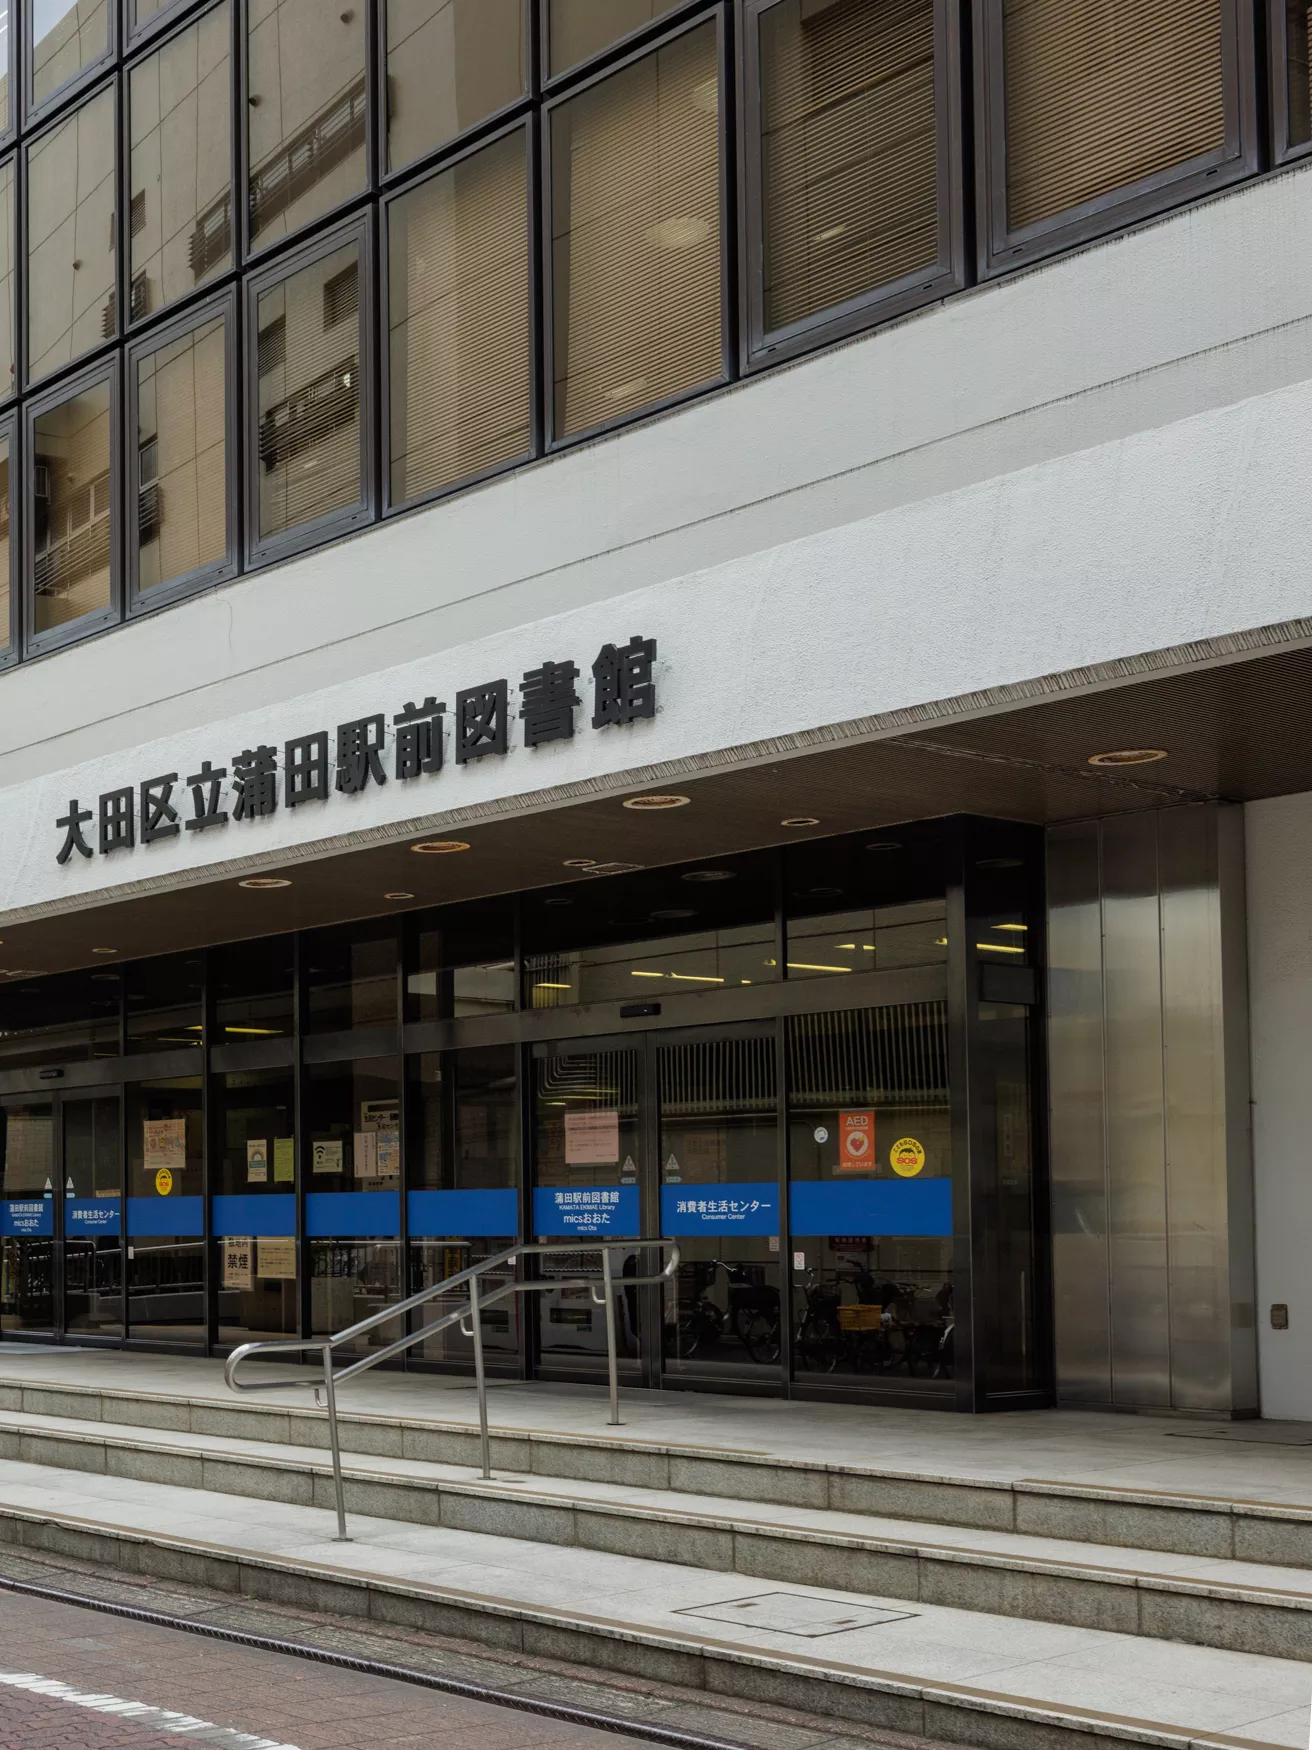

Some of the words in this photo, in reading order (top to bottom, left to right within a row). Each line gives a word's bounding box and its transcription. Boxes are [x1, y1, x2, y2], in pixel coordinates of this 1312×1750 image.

[55, 636, 657, 865] 大田区立蒲田駅前図書館
[846, 1115, 869, 1126] AED
[896, 1157, 918, 1165] SOS
[554, 1192, 620, 1204] 蒲田駅前図書館
[599, 1204, 616, 1212] Library
[676, 1200, 772, 1213] 消費者生活センター
[72, 1209, 120, 1220] 消費者生活センター
[563, 1212, 611, 1224] micsおおた
[227, 1253, 249, 1269] 禁煙
